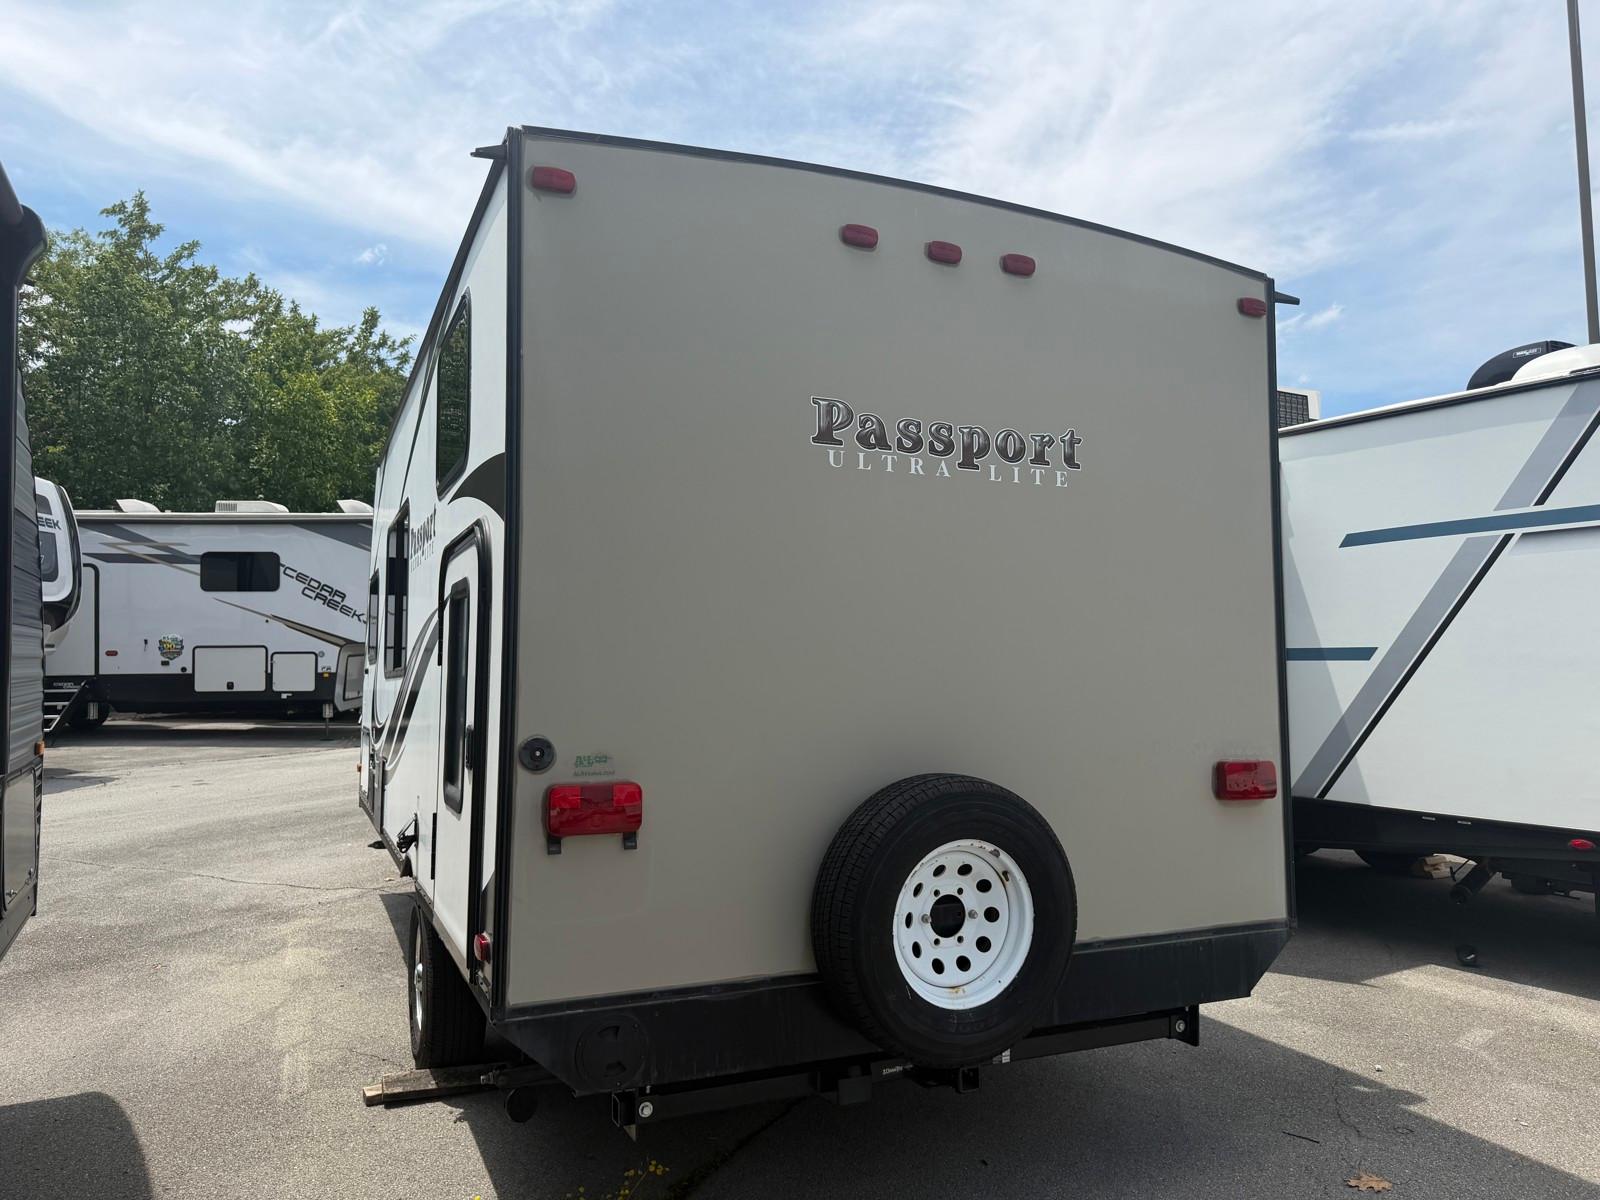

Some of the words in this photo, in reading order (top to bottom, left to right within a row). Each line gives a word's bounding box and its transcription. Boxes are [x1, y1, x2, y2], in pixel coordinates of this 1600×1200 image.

[811, 396, 1083, 471] Passport
[827, 449, 951, 478] ULTRA
[989, 465, 1068, 487] LITE
[38, 516, 62, 530] EEK
[283, 566, 347, 603] CEDAR
[301, 587, 365, 622] CREEK
